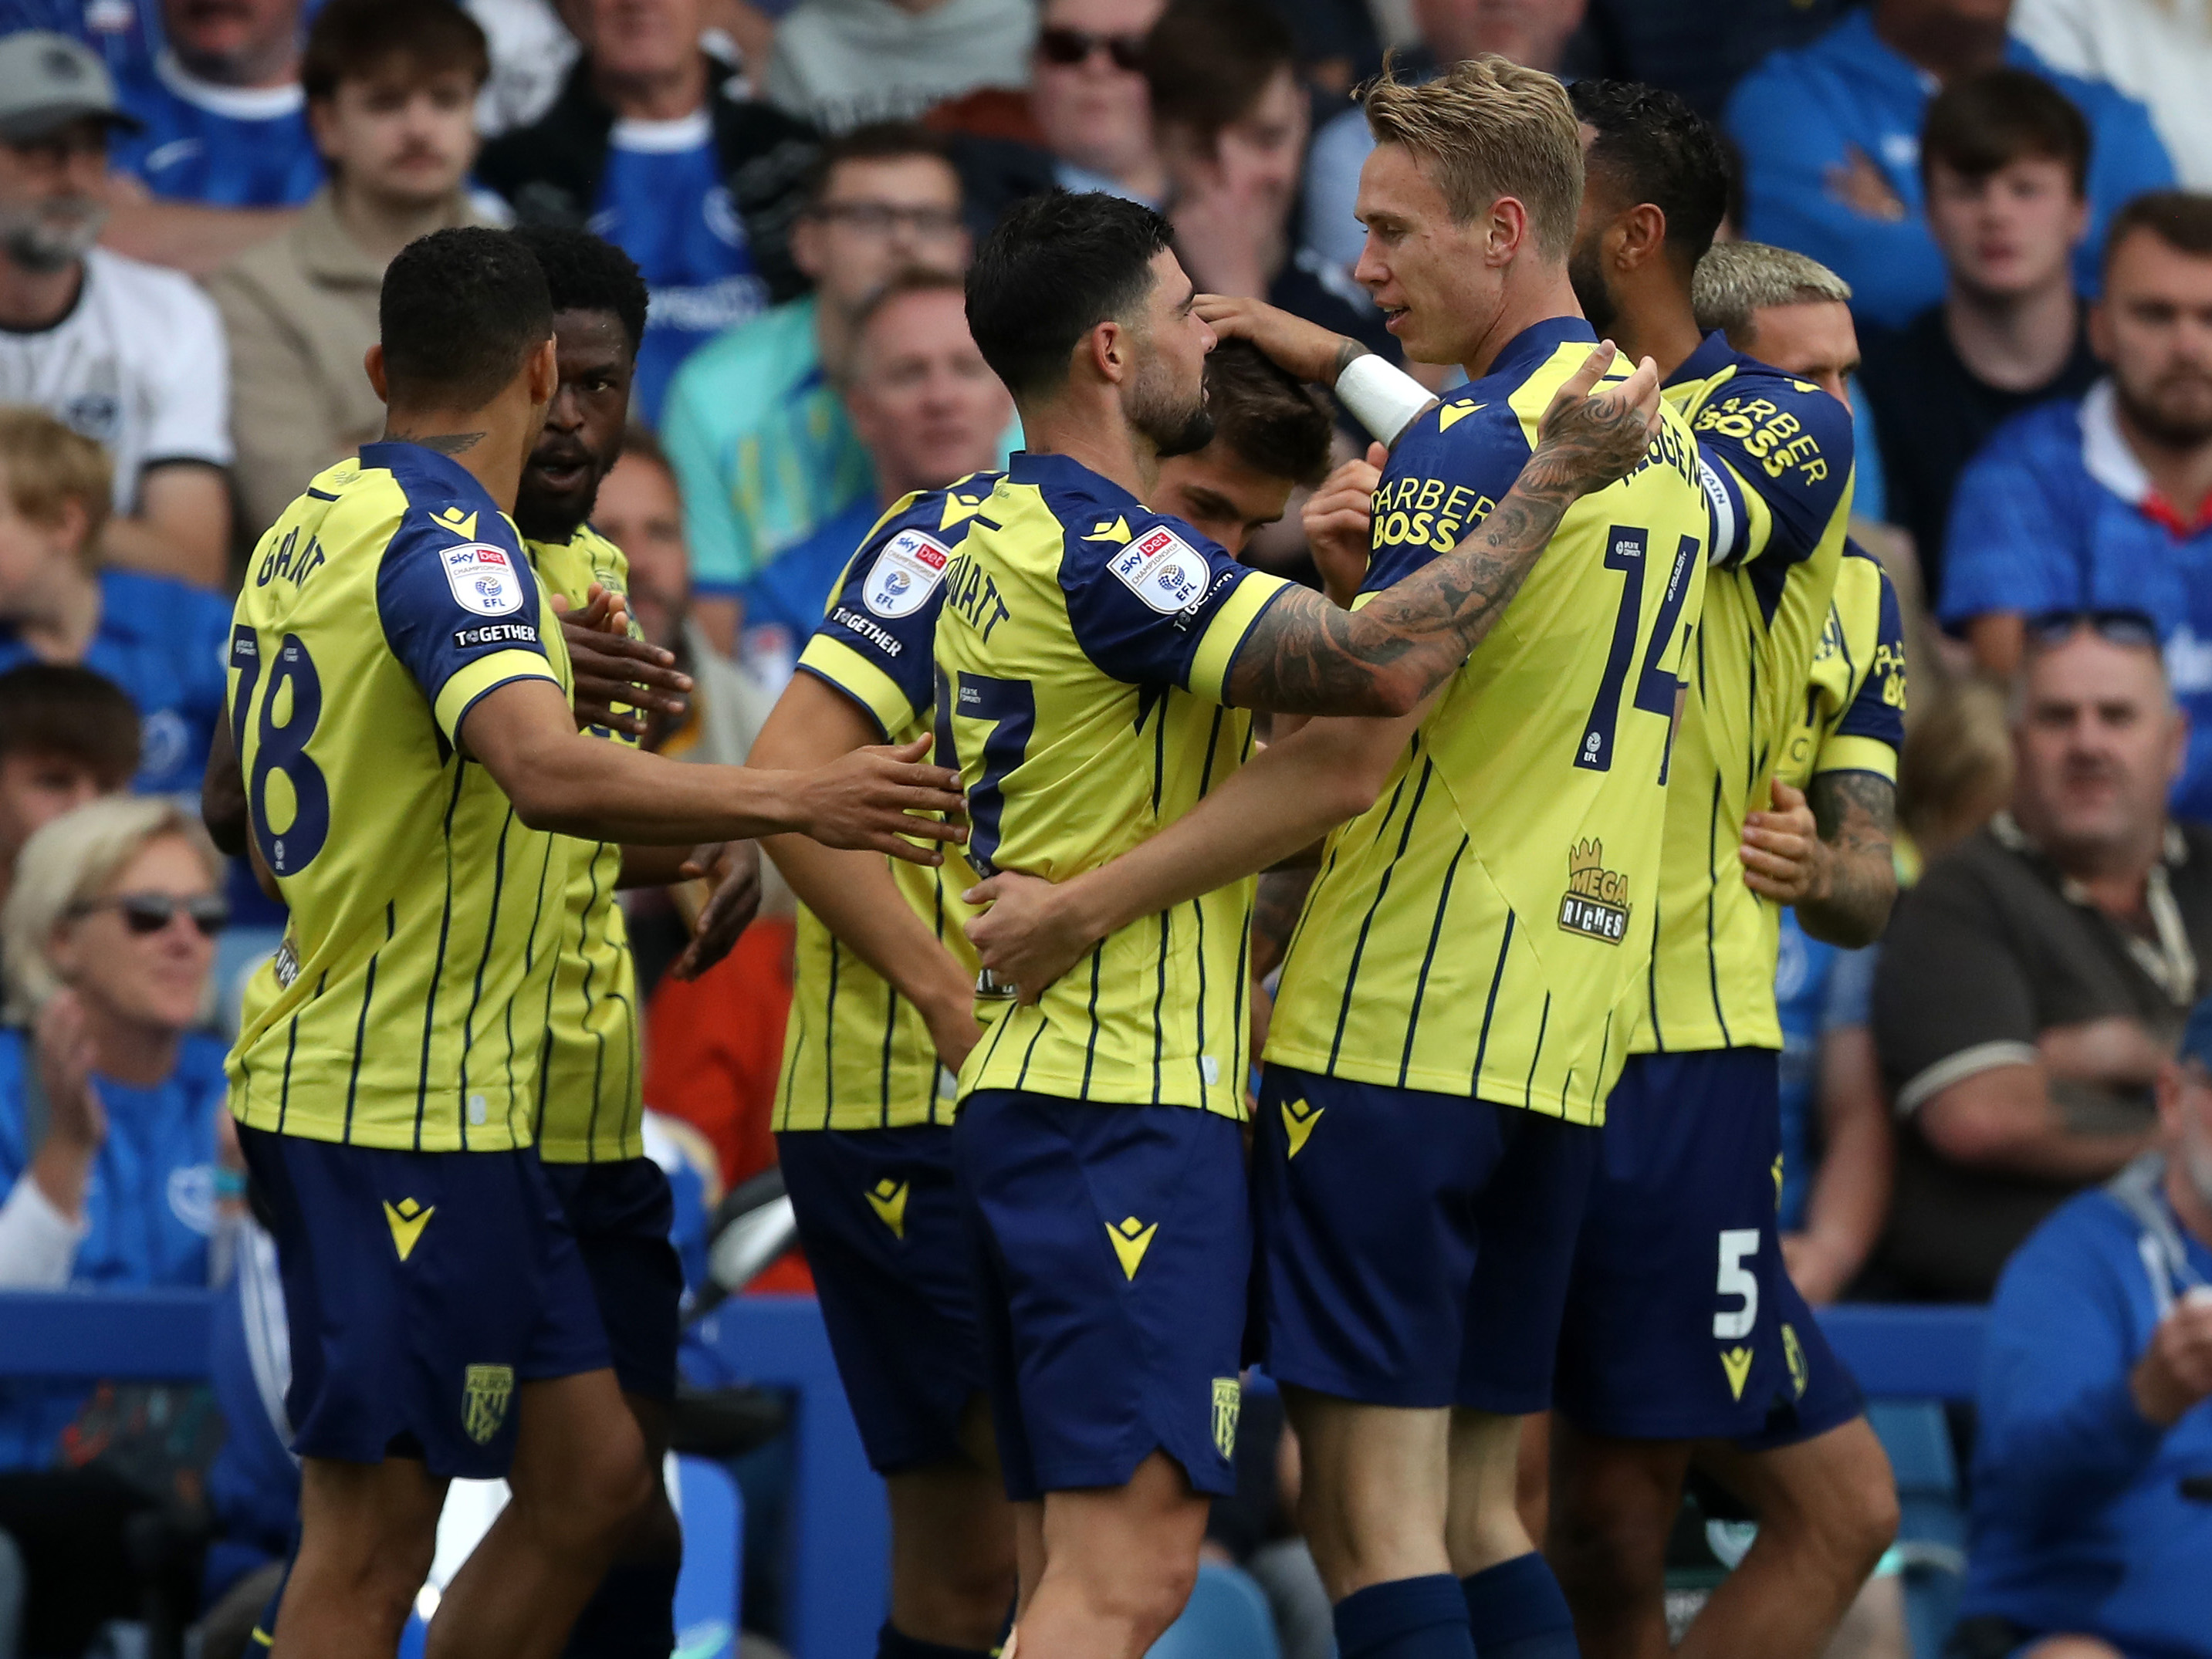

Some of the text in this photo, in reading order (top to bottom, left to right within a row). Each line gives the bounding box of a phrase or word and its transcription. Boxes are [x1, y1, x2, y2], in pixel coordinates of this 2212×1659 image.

[1699, 397, 1828, 487] ARBER
[1700, 465, 1726, 505] TAIN
[896, 536, 945, 567] sky bet
[1372, 511, 1459, 553] BOSS
[449, 550, 503, 565] sky bet
[1121, 535, 1169, 575] sky bet
[1131, 543, 1179, 584] CHAMPIONSHIP
[483, 598, 506, 608] EFL
[874, 593, 895, 610] EFL
[1175, 582, 1197, 602] EFL
[1573, 525, 1700, 786] 14
[934, 661, 1036, 877] 7
[1584, 752, 1598, 763] EFL
[1570, 869, 1628, 907] MEGA
[1562, 900, 1623, 937] RICHES
[1713, 1228, 1760, 1340] 5
